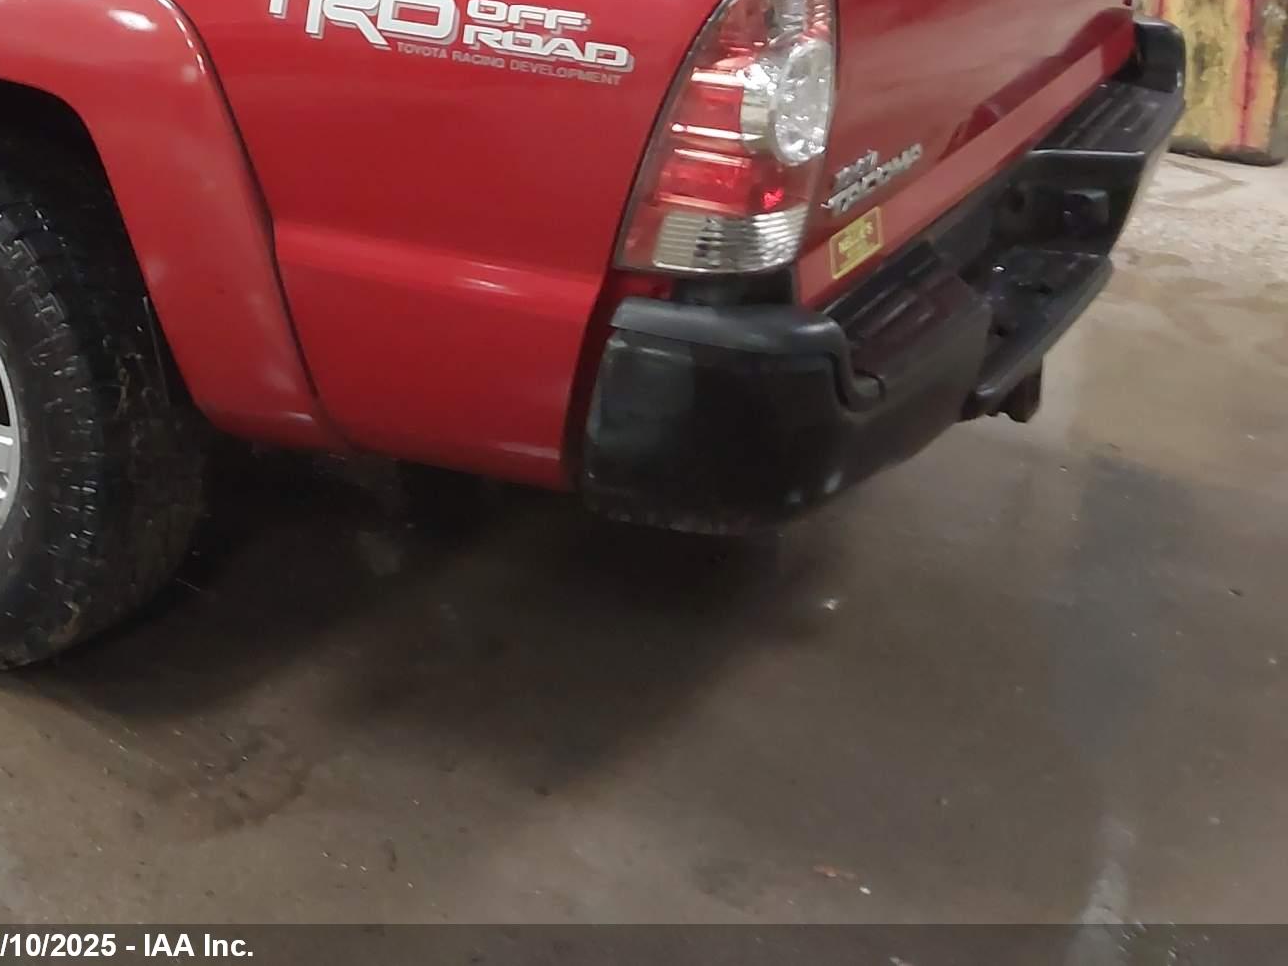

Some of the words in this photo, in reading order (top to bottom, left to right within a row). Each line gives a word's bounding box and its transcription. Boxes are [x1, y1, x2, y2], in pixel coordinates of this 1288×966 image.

[397, 41, 448, 61] TOYOTA
[451, 50, 506, 70] RACING
[509, 59, 623, 86] DEVELOPMENT
[463, 25, 634, 73] ROAD
